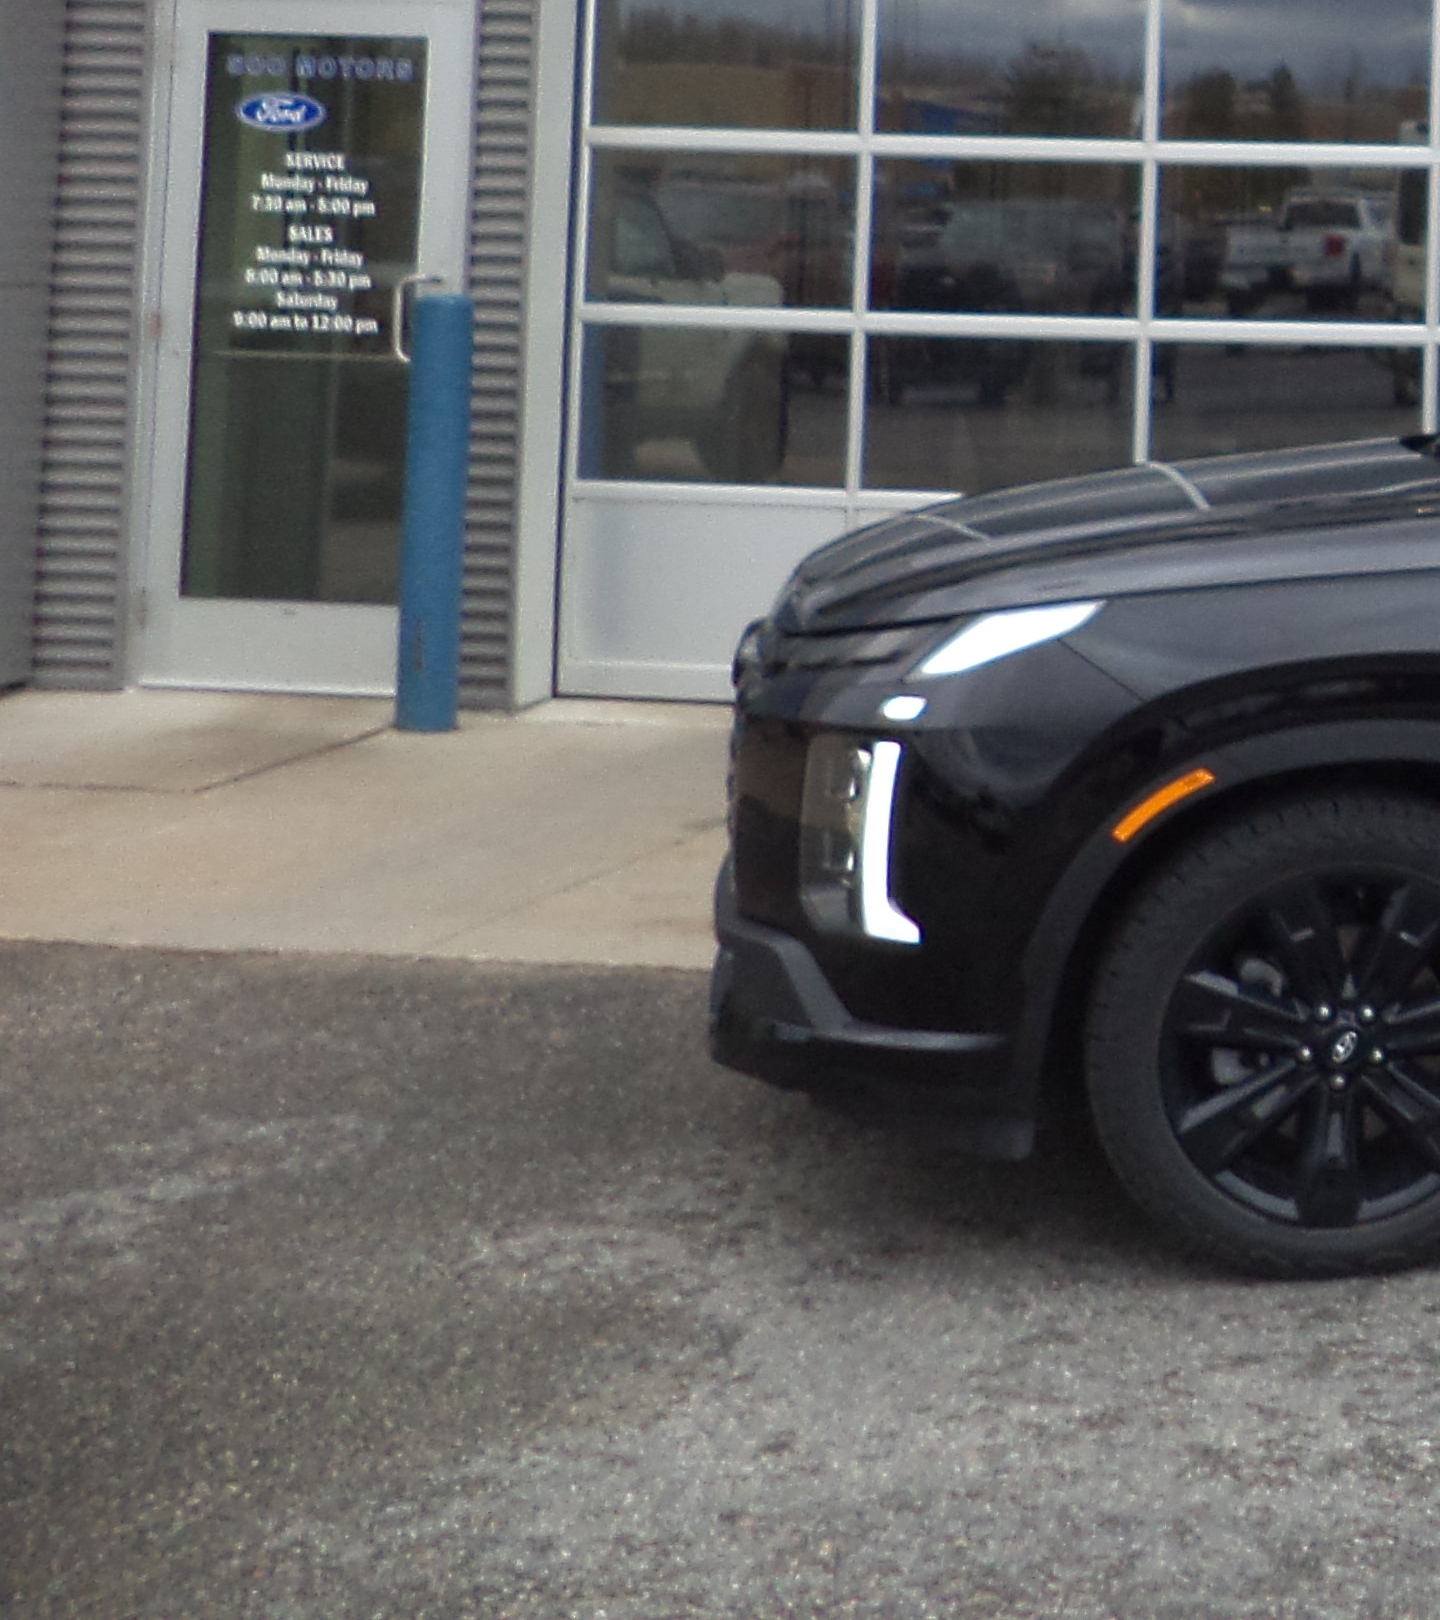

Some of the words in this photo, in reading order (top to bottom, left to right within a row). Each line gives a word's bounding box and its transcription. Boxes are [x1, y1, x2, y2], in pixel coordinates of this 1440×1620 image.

[296, 56, 414, 81] MOTORS
[285, 152, 346, 170] SERVICE
[261, 172, 315, 193] Monday
[325, 175, 369, 197] Friday
[288, 224, 333, 242] SALES
[256, 246, 310, 266] Monday
[320, 248, 364, 269] Friday
[276, 291, 339, 311] Saturday
